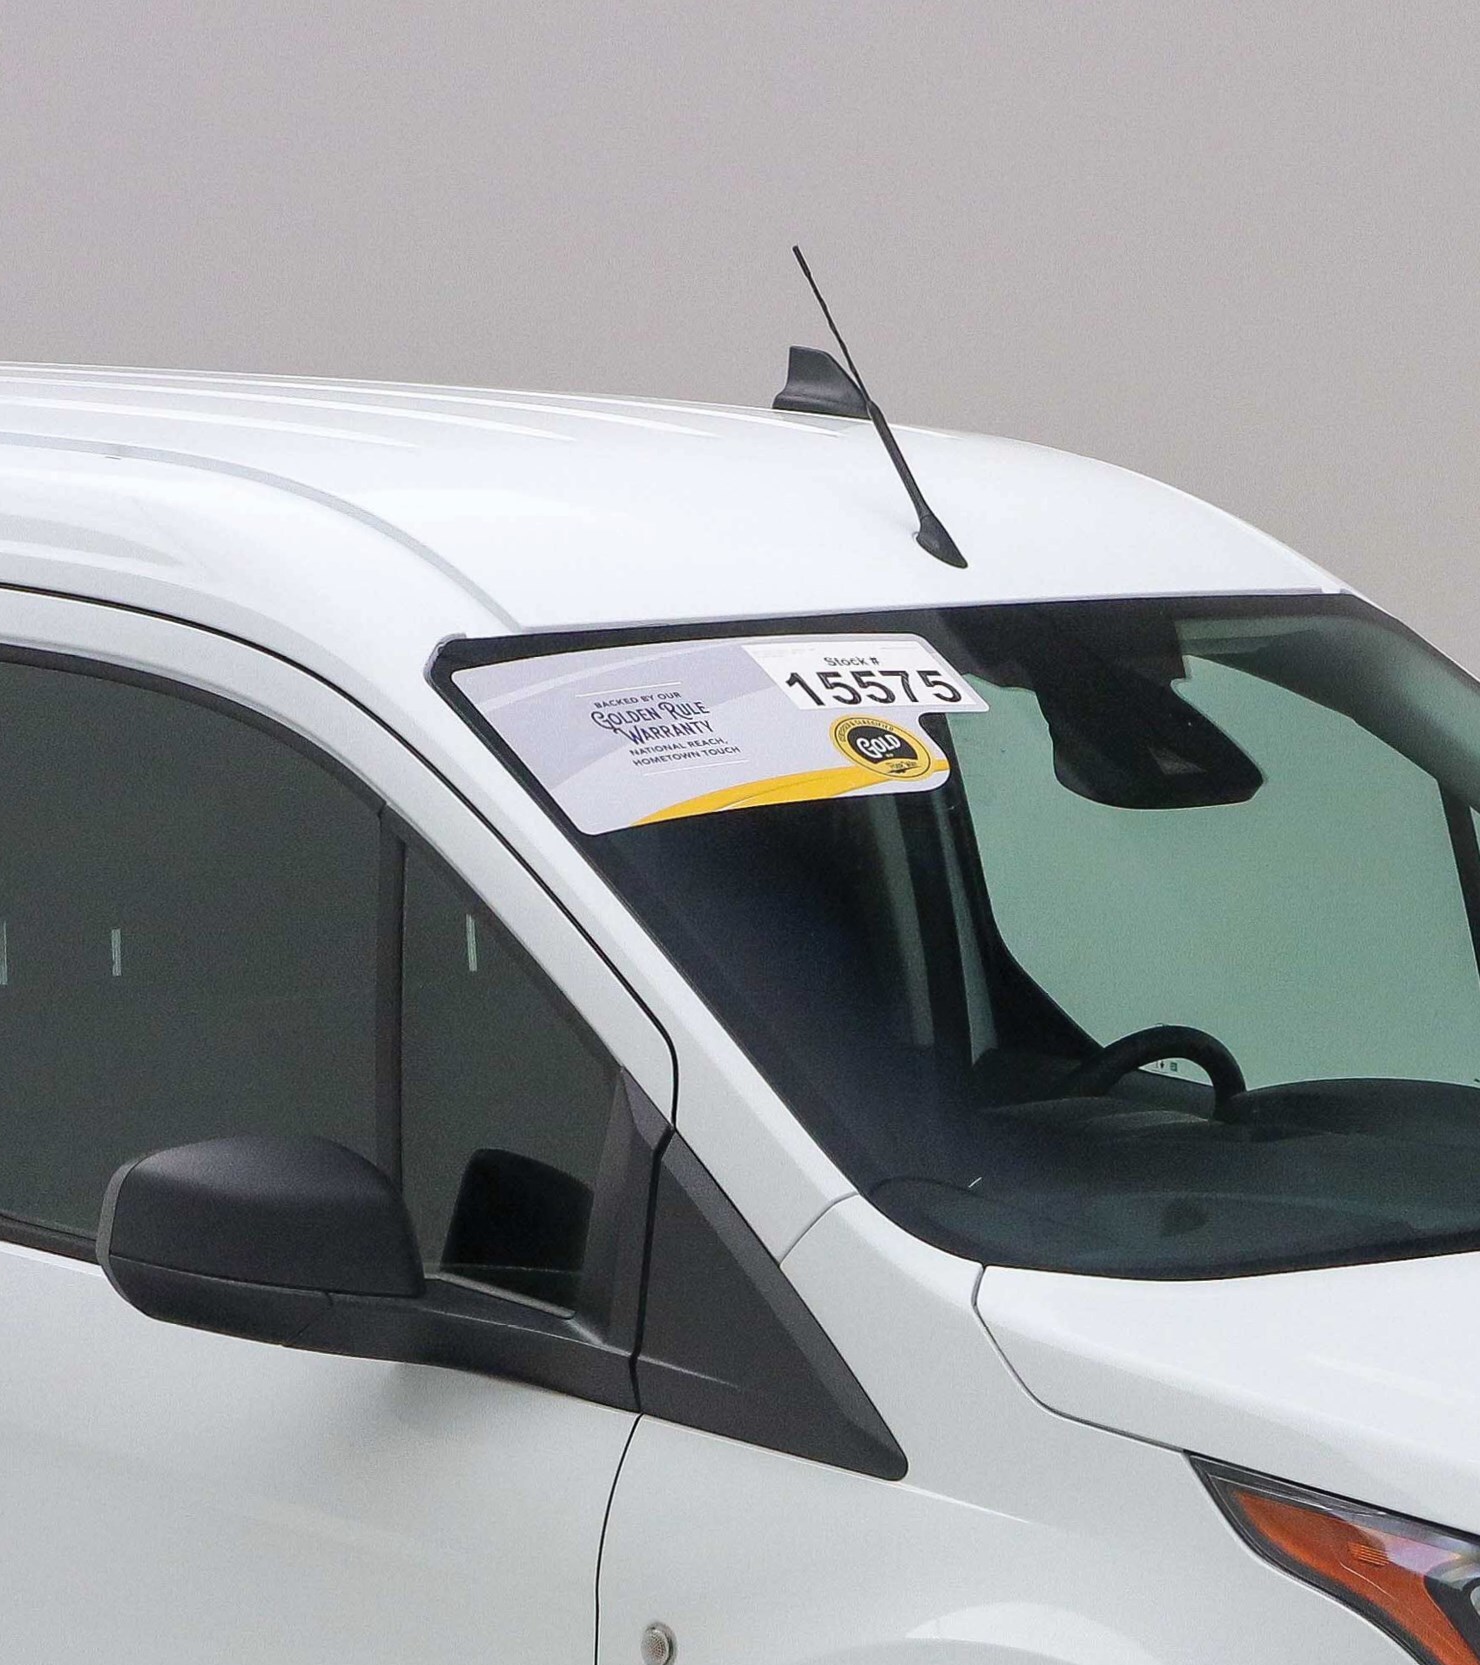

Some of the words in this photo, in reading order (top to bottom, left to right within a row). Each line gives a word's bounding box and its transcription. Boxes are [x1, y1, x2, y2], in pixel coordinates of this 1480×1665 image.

[823, 656, 866, 667] Stock
[868, 656, 881, 666] #
[785, 670, 963, 706] 15575
[594, 696, 639, 709] BACKED
[640, 695, 655, 703] BY
[657, 691, 682, 701] OUR
[613, 720, 714, 746] WARRANTY
[629, 742, 687, 756] NATIONAL
[688, 737, 729, 748] REACH,
[632, 751, 701, 766] HOMETOWN
[702, 746, 741, 758] TOUCH
